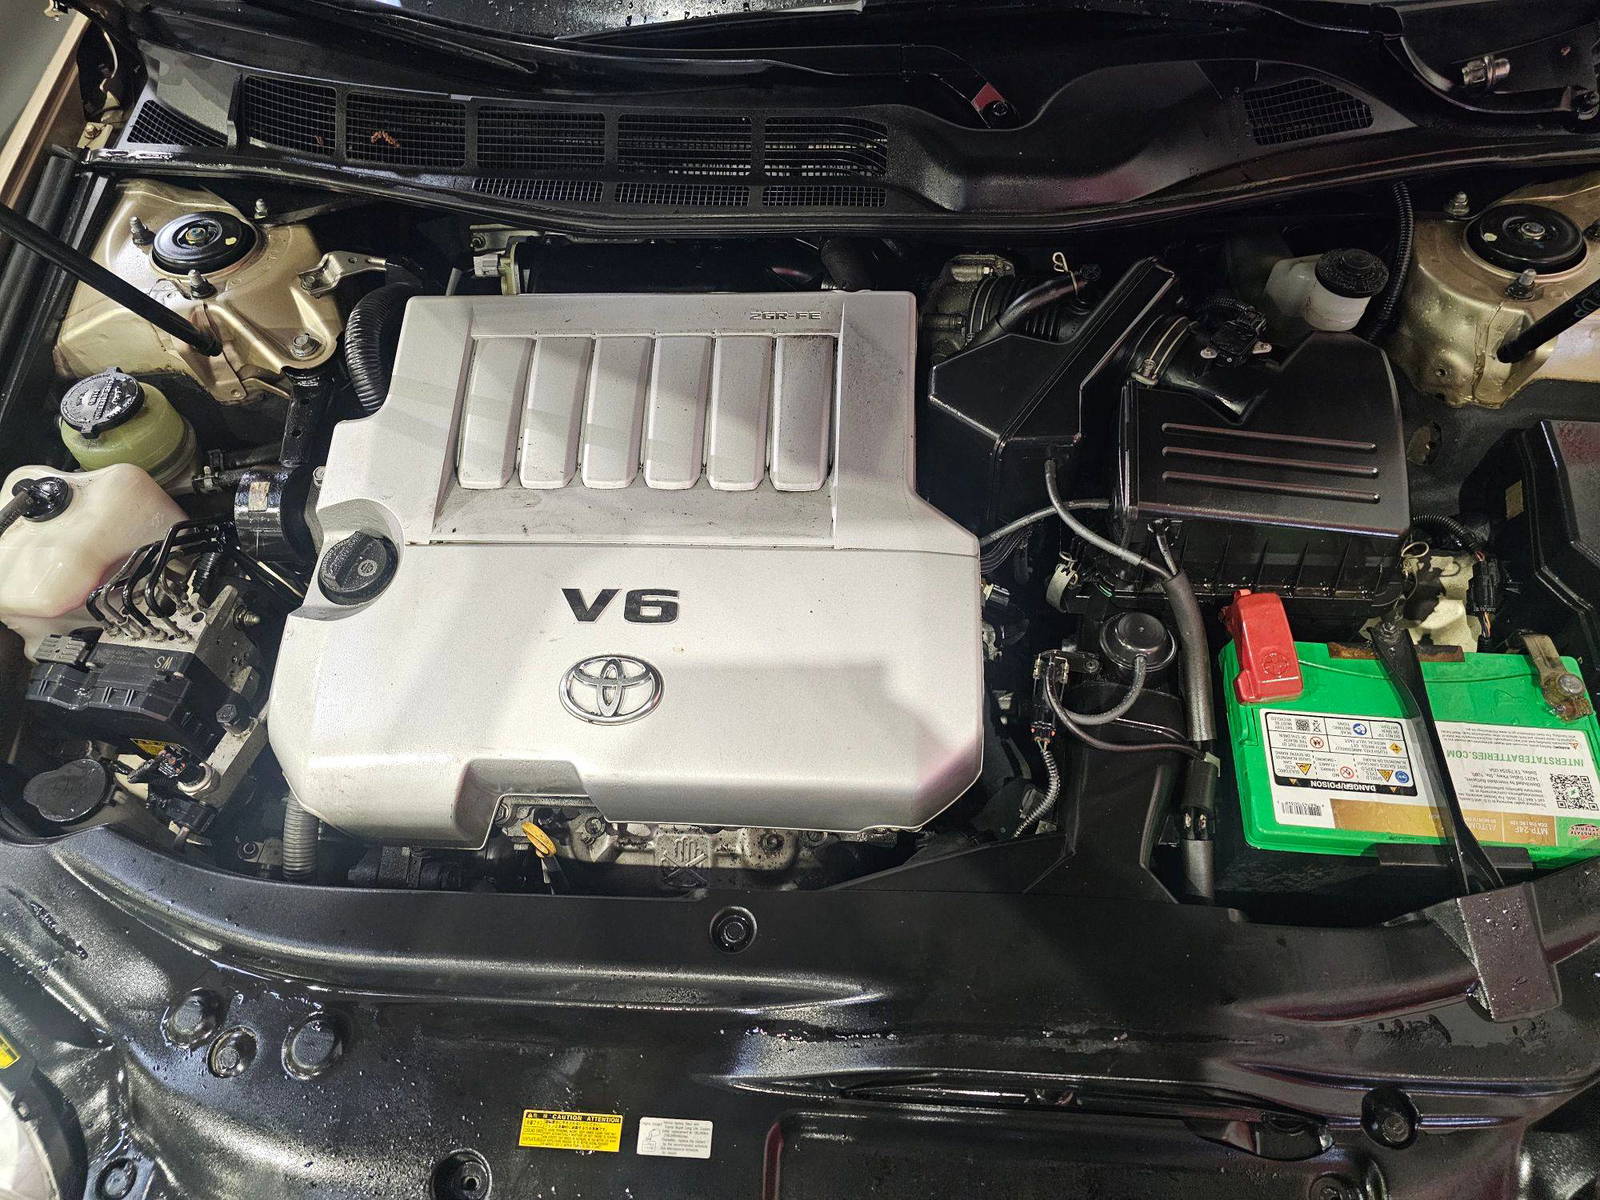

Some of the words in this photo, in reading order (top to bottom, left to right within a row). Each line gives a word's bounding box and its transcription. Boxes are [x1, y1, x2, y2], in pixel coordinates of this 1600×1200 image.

[749, 311, 821, 320] 2GR-FE
[561, 587, 680, 624] V6
[1447, 749, 1584, 767] INTERSTATEBATTERIES.COM
[1310, 780, 1376, 792] DANGER/POISON
[552, 1113, 583, 1121] CAUTION
[586, 1115, 620, 1123] ATTENTION
